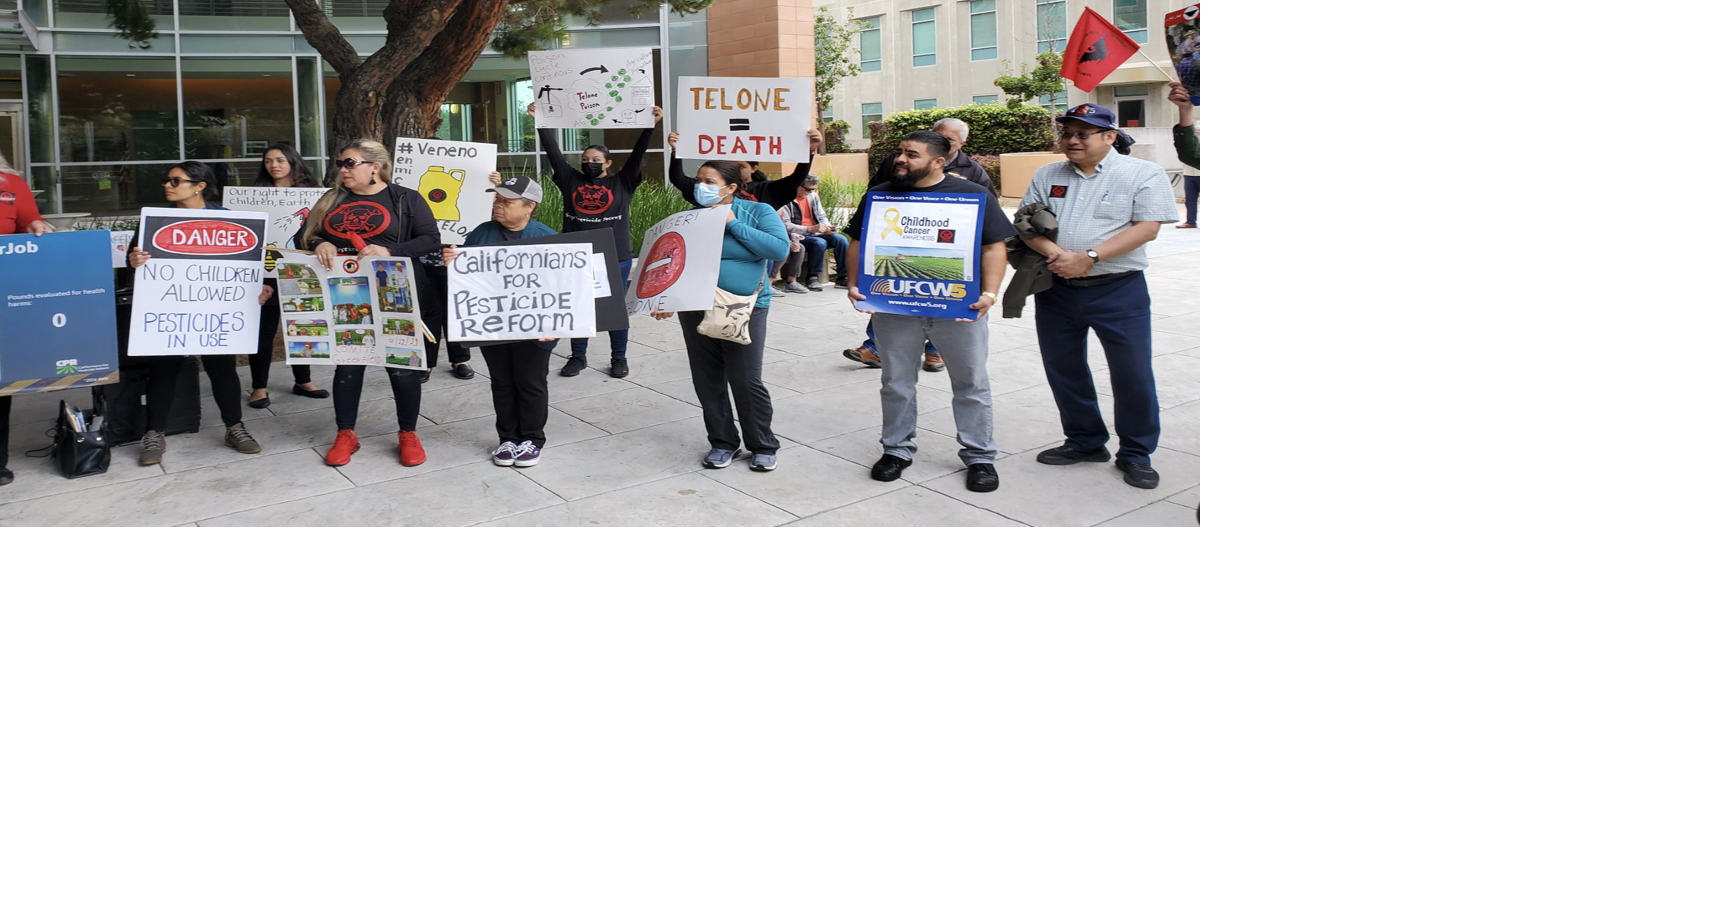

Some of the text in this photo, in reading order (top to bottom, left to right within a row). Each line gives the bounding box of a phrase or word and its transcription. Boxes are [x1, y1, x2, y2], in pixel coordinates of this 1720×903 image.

[577, 91, 598, 101] Telone
[690, 87, 790, 112] TELONE
[580, 102, 600, 110] Poison
[418, 142, 478, 158] Veneno
[698, 134, 782, 155] DEATH
[229, 188, 250, 196] Our
[253, 187, 281, 200] right
[283, 188, 296, 197] to
[279, 198, 311, 206] Earth
[438, 219, 471, 238] ELO
[900, 216, 950, 228] Childhood
[172, 228, 249, 247] DANGER
[903, 225, 931, 235] Cancer
[453, 248, 587, 274] Californians
[143, 263, 260, 283] NO CHILDREN
[503, 272, 542, 289] FOR
[7, 293, 34, 301] Pounds
[35, 290, 71, 299] evaluated
[83, 287, 106, 295] health
[160, 284, 246, 302] ALLOWED
[888, 300, 947, 310] www.ufcw5.org
[52, 313, 67, 328] 0
[144, 311, 245, 333] PESTICIDES
[167, 333, 229, 348] IN USE
[56, 358, 78, 367] CPR
